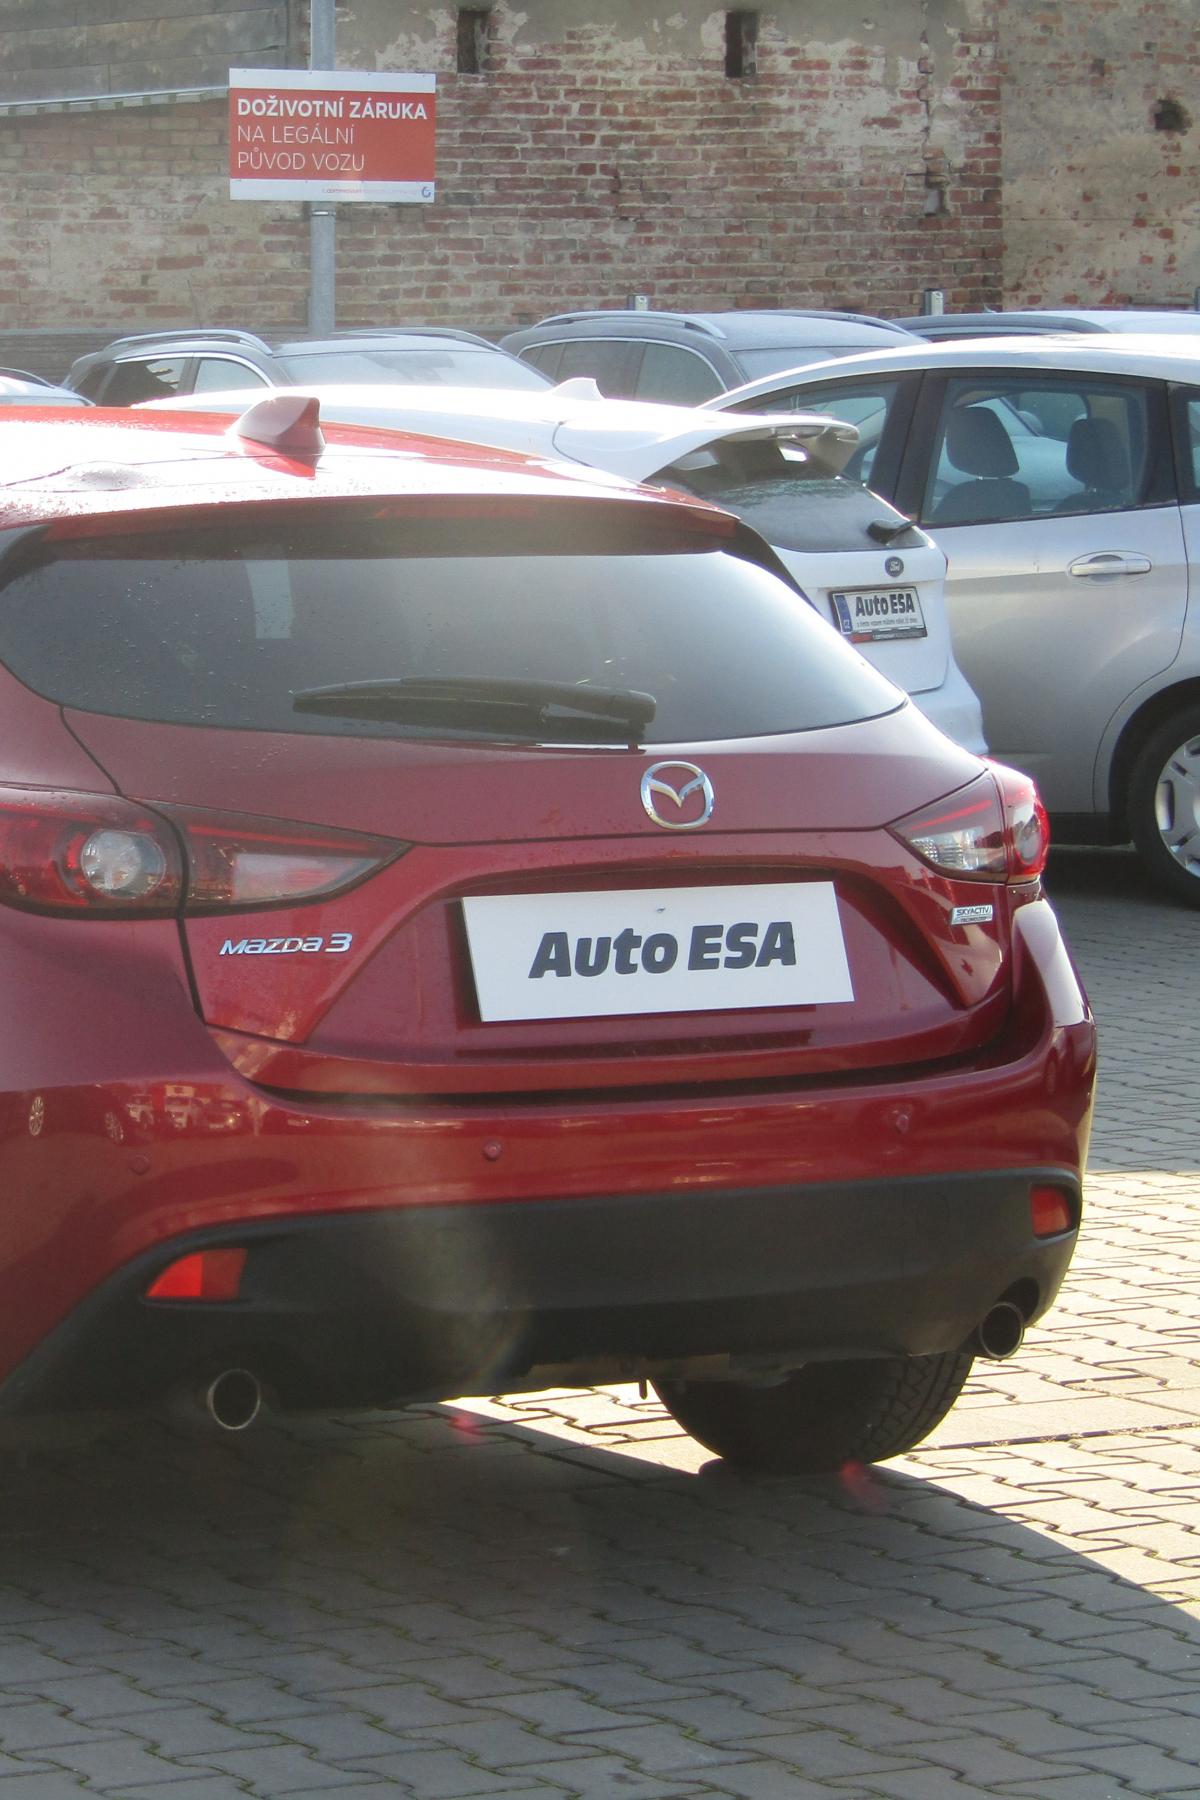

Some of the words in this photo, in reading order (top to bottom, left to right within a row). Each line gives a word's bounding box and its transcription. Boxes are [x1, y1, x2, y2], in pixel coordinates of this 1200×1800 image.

[237, 95, 344, 118] DOŽIVOTNÍ
[349, 97, 428, 120] ZÁRUKA
[237, 125, 266, 143] NA
[272, 123, 355, 144] LEGÁLNÍ
[237, 147, 306, 170] PŮVOD
[312, 153, 365, 172] VOZU
[856, 596, 889, 617] Auto
[889, 593, 915, 614] ESA
[528, 928, 678, 979] Auto
[687, 921, 797, 971] ESA
